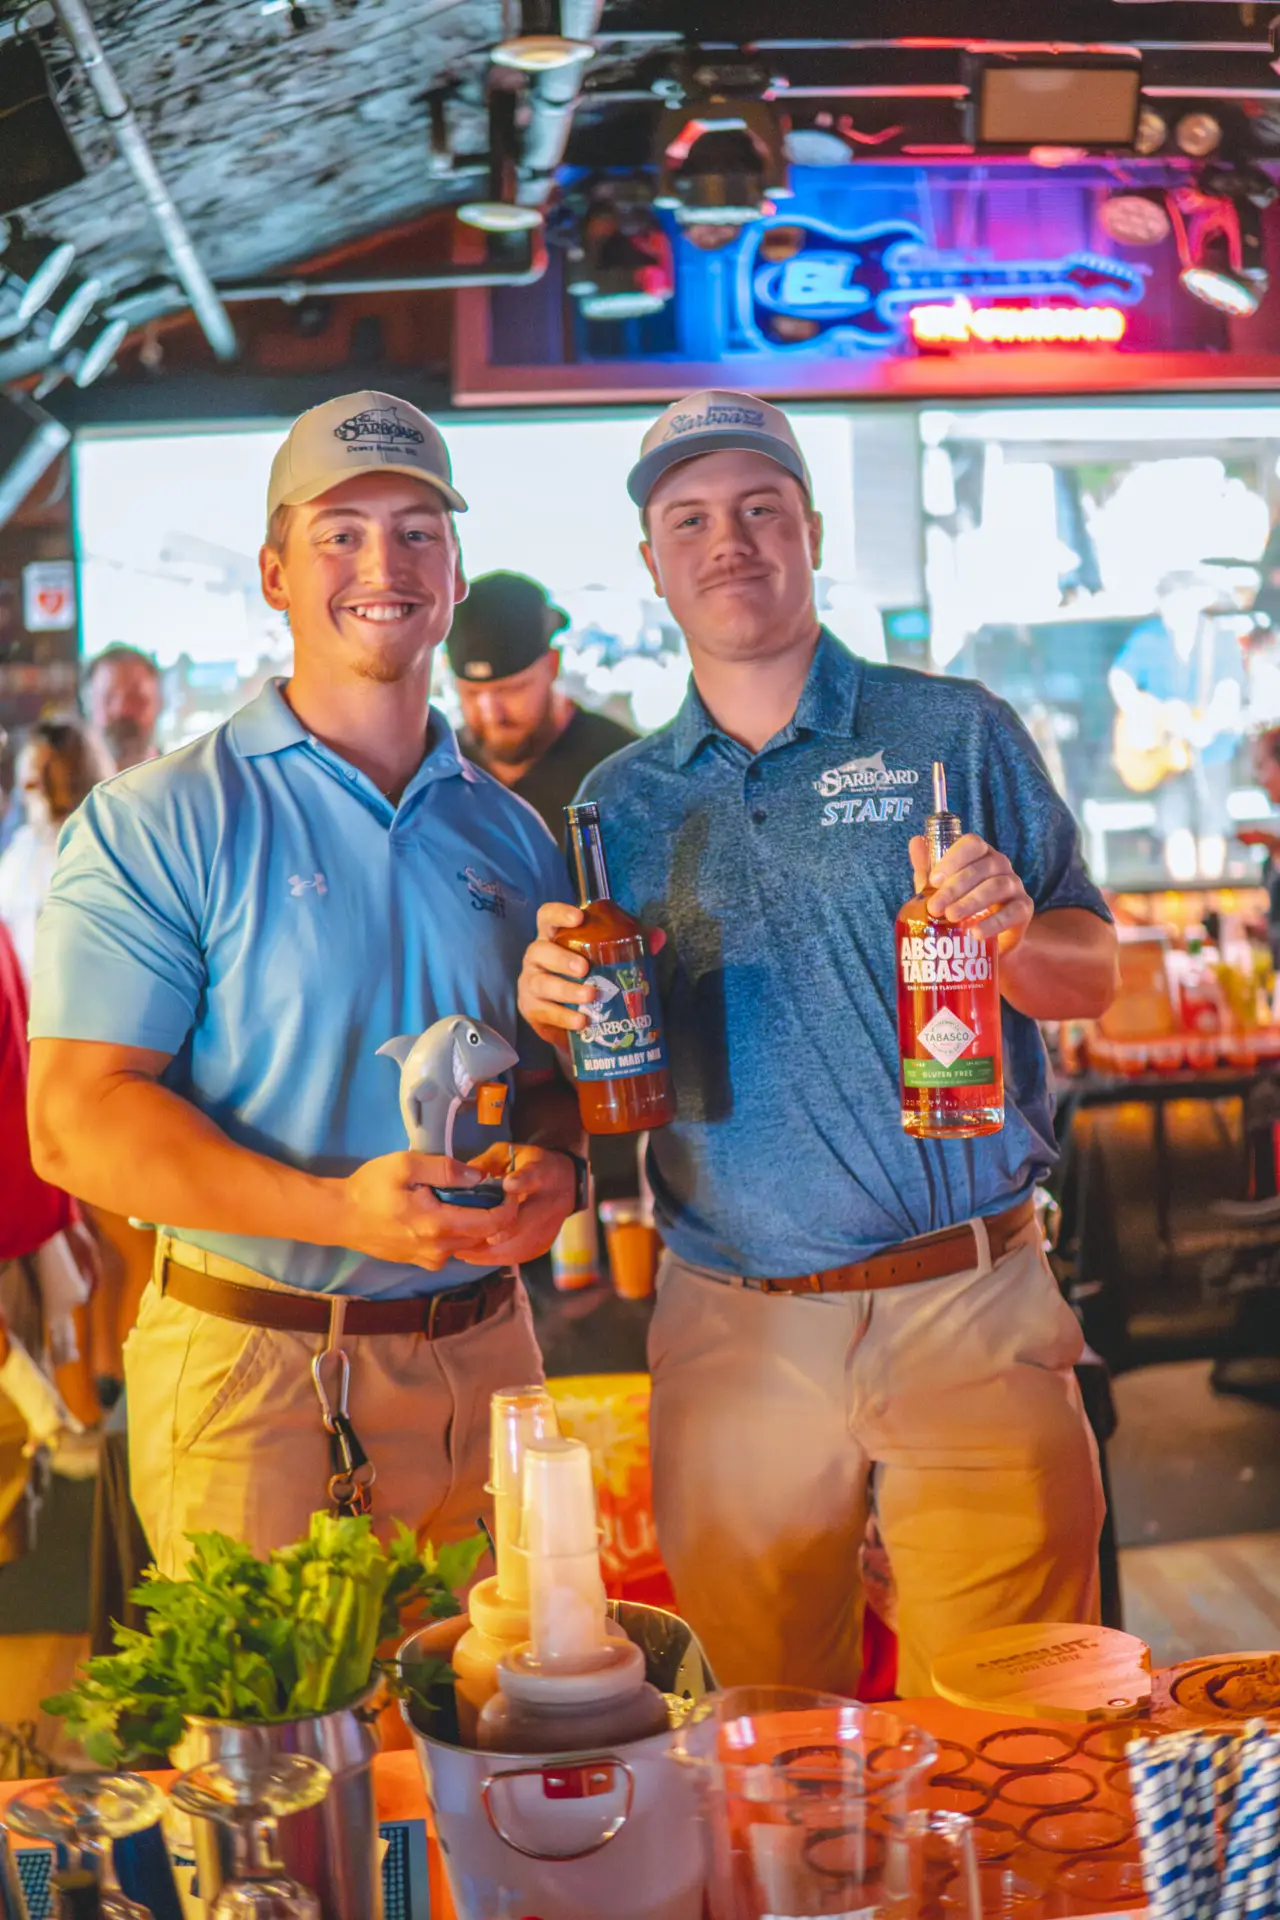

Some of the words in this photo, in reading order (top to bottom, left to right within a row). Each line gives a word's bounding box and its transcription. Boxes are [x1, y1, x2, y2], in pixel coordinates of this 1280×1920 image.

[820, 768, 920, 797] STARBOARD
[821, 797, 914, 827] STAFF
[901, 957, 988, 983] TABASCO
[924, 1032, 970, 1042] TABASCO
[583, 1057, 616, 1071] BLOODY
[618, 1052, 645, 1067] MARY
[922, 1070, 953, 1079] GLUTEN
[954, 1069, 974, 1077] FREE
